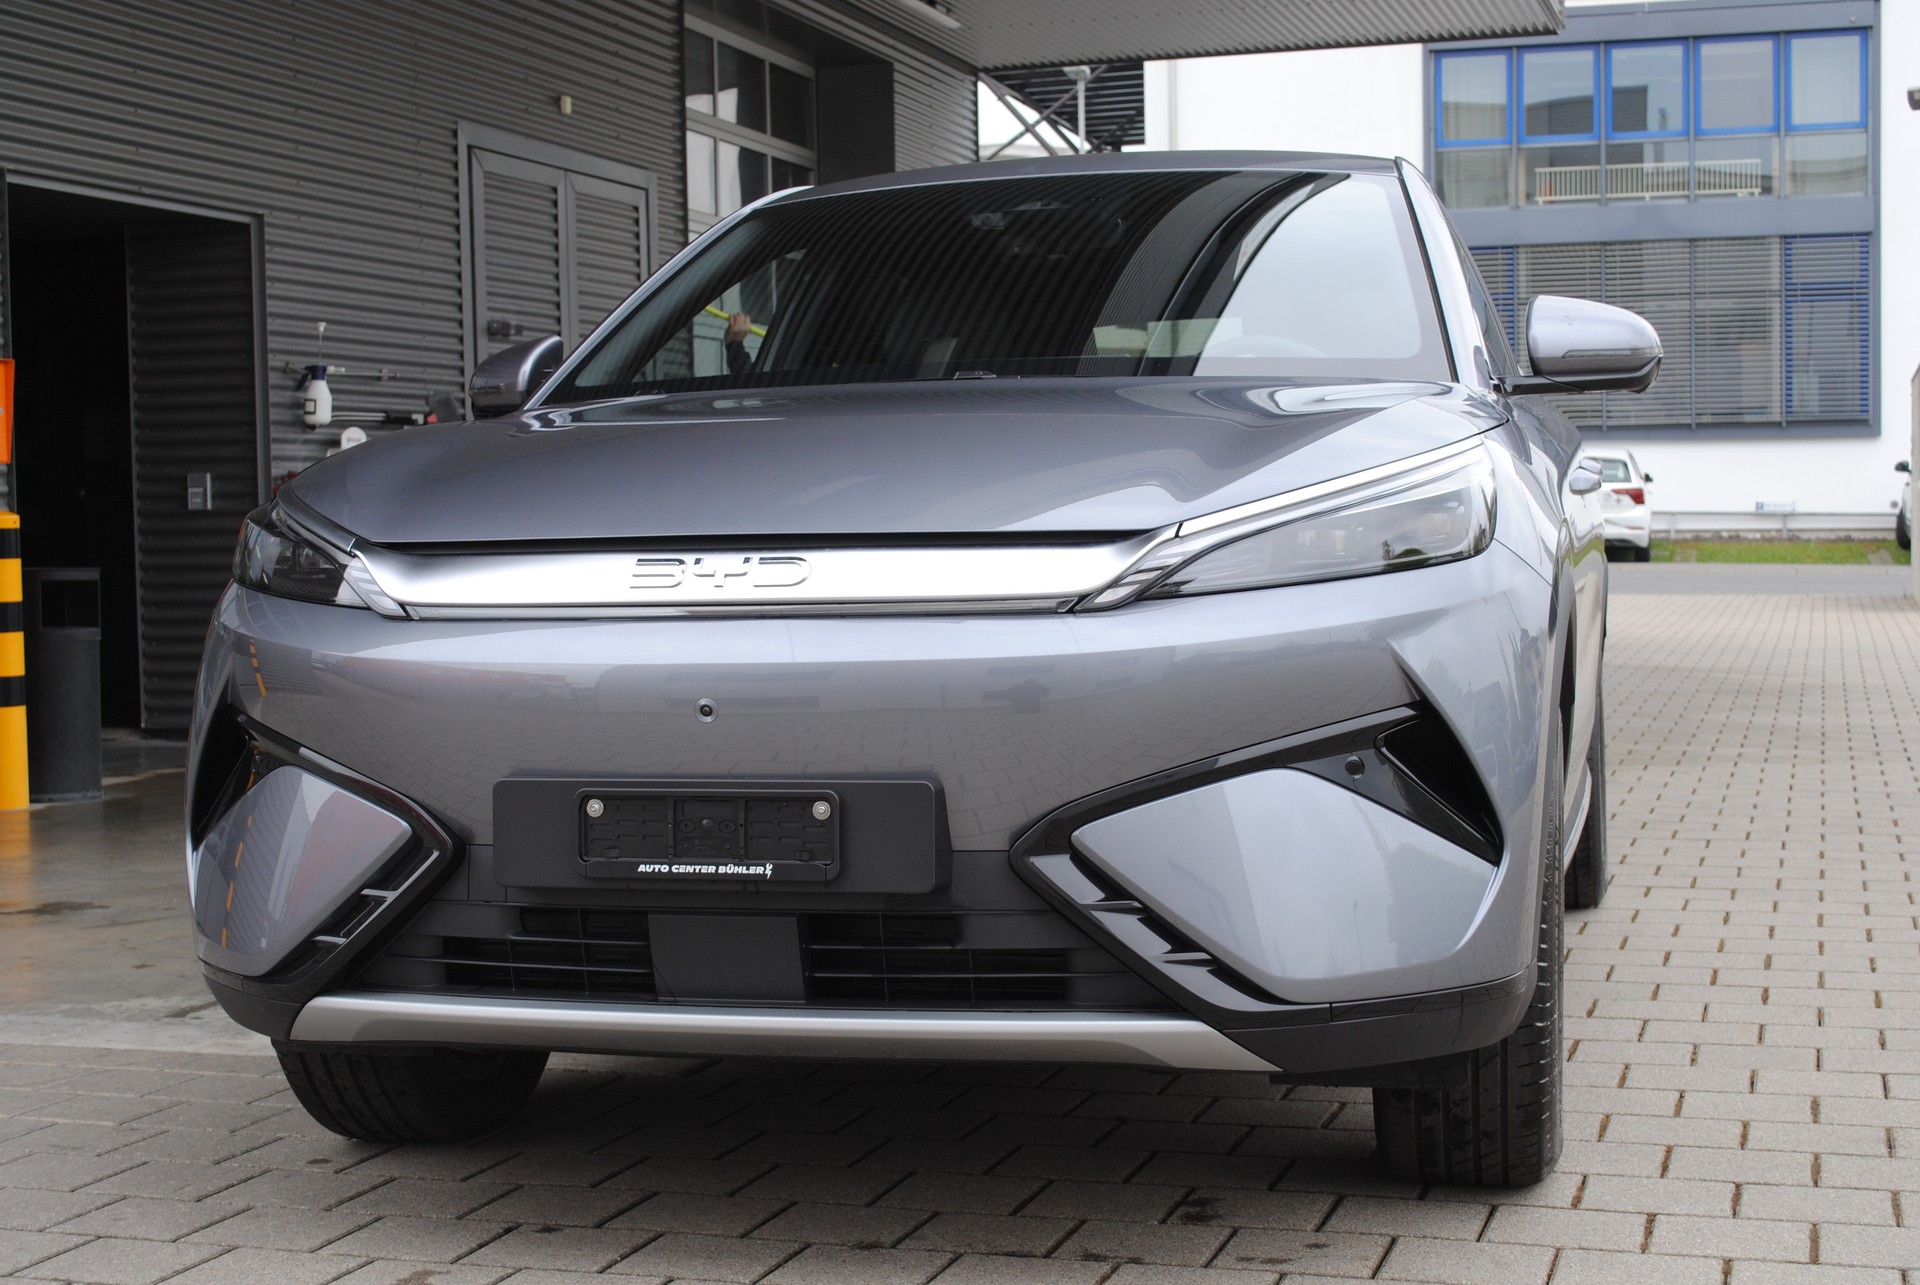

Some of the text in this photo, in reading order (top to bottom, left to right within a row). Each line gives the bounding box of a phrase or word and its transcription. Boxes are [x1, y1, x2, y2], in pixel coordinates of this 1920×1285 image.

[629, 556, 812, 589] BYD
[637, 863, 764, 875] AUTO CENTER BÜHLER
